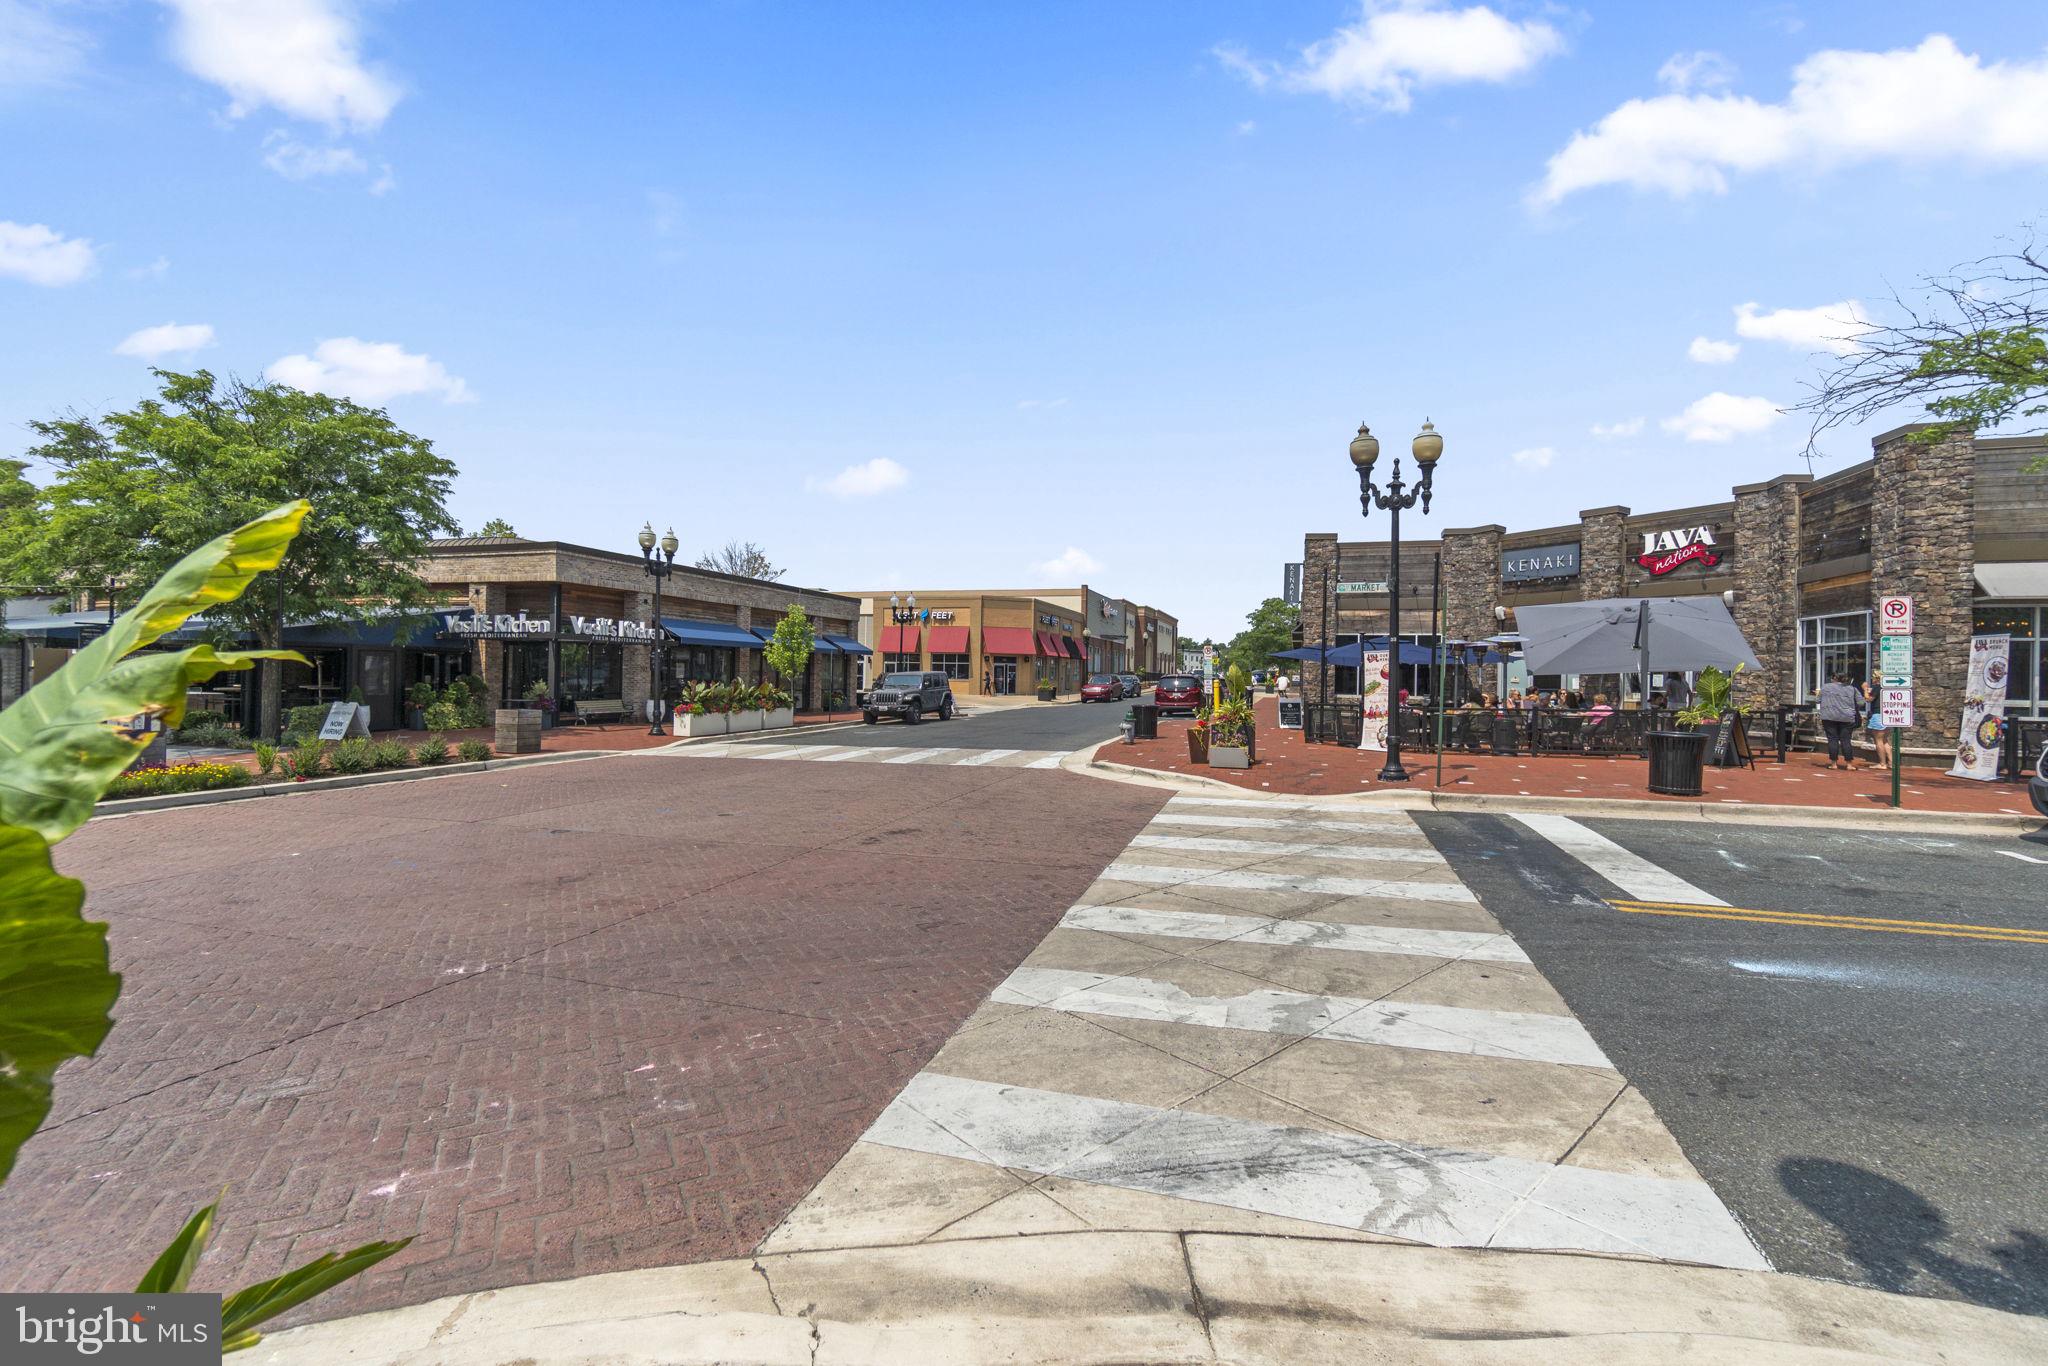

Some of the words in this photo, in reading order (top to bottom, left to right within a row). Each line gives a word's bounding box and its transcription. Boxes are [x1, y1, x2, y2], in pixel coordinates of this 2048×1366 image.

[1642, 526, 1716, 555] JAVA
[1507, 554, 1573, 573] KENAKI
[1655, 545, 1700, 572] nation
[444, 614, 493, 633] Vasili's
[494, 613, 551, 633] Kitchen
[931, 612, 953, 620] FEET
[570, 616, 617, 637] Vasili's
[1890, 692, 1903, 700] NO
